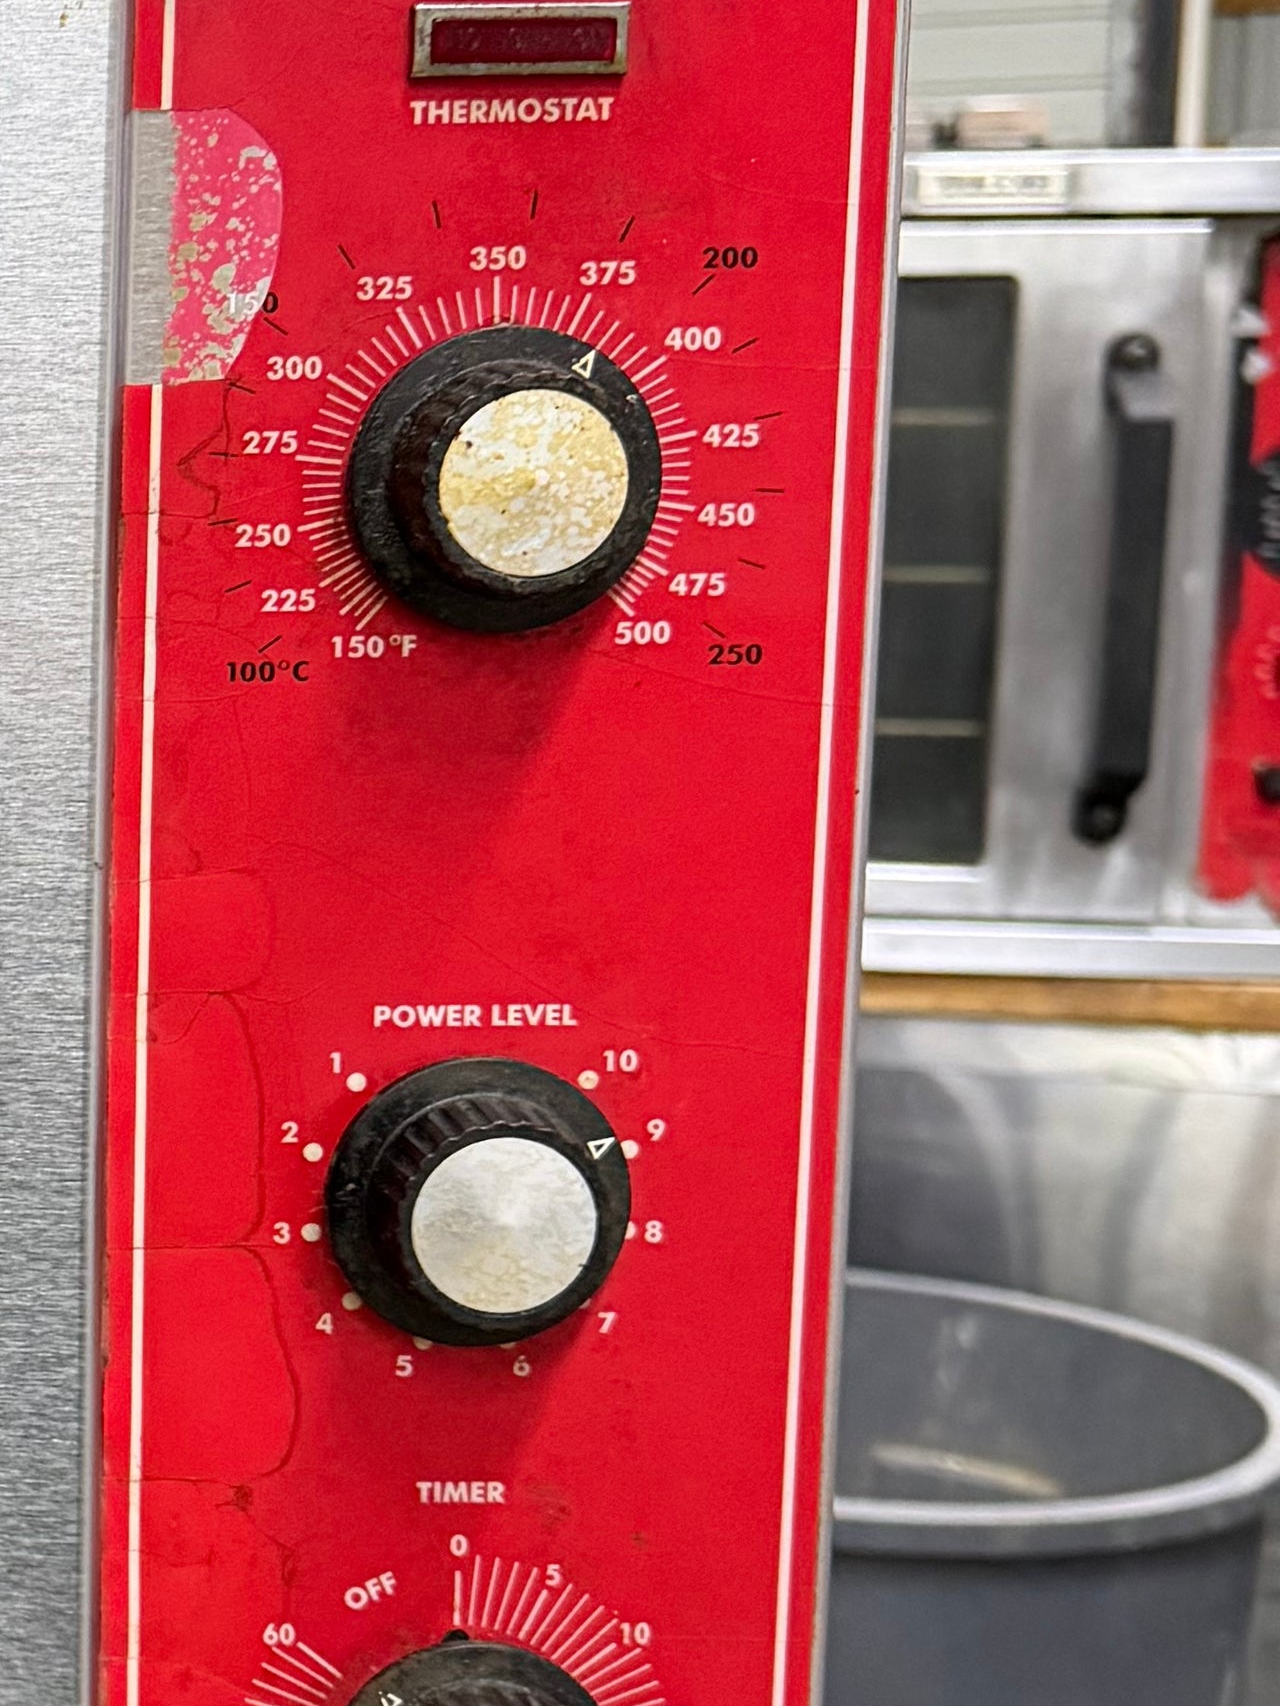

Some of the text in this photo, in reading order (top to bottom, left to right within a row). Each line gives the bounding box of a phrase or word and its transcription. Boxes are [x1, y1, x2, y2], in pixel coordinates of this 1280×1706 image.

[410, 97, 614, 125] THERMOSTAT
[470, 246, 526, 271] 350
[702, 246, 758, 269] 200
[580, 261, 636, 286] 375
[357, 276, 413, 301] 325
[227, 292, 278, 314] 150
[665, 327, 721, 350] 400
[267, 356, 323, 380] 300
[242, 431, 298, 455] 275
[702, 423, 759, 447] 425
[698, 504, 755, 527] 450
[235, 524, 291, 548] 250
[669, 573, 725, 597] 475
[261, 589, 316, 612] 225
[615, 621, 670, 644] 500
[708, 644, 763, 666] 250
[373, 1004, 578, 1028] POWER LEVEL
[330, 1052, 342, 1074] 1
[603, 1050, 639, 1072] 10
[281, 1121, 299, 1143] 2
[646, 1119, 666, 1141] 9
[273, 1222, 291, 1244] 3
[644, 1221, 663, 1244] 8
[315, 1313, 333, 1335] 4
[598, 1312, 617, 1334] 7
[395, 1356, 413, 1378] 5
[513, 1356, 531, 1377] 6
[416, 1481, 506, 1504] TIMER
[449, 1534, 469, 1557] 0
[545, 1564, 561, 1587] 5
[344, 1571, 399, 1612] OFF
[262, 1623, 297, 1646] 60
[620, 1622, 650, 1645] 10
